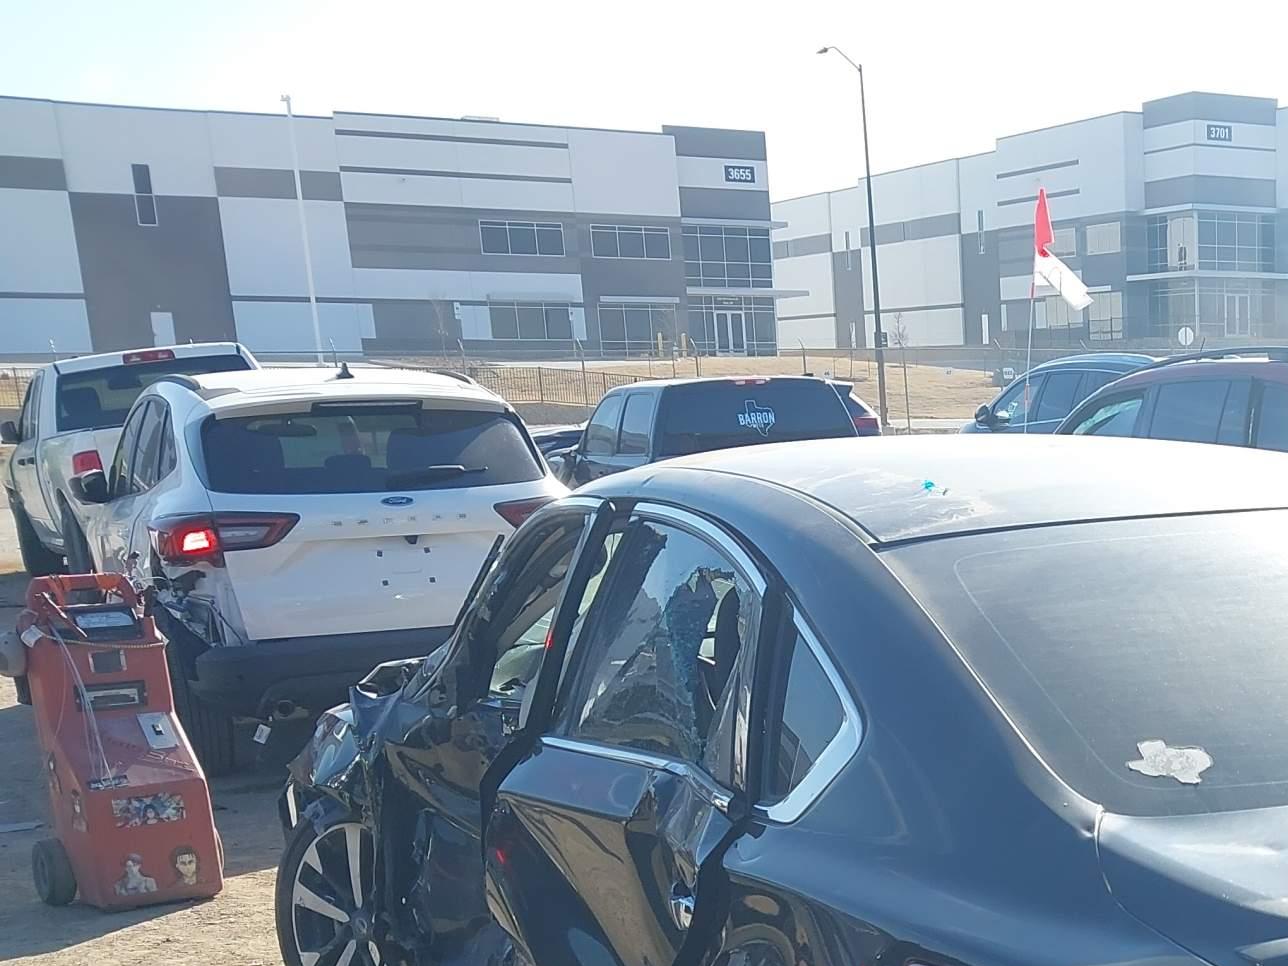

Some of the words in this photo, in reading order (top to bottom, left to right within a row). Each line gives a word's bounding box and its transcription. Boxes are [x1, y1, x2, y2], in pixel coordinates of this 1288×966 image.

[1210, 127, 1229, 139] 3701
[728, 168, 752, 180] 3655
[737, 412, 775, 425] BARRON
